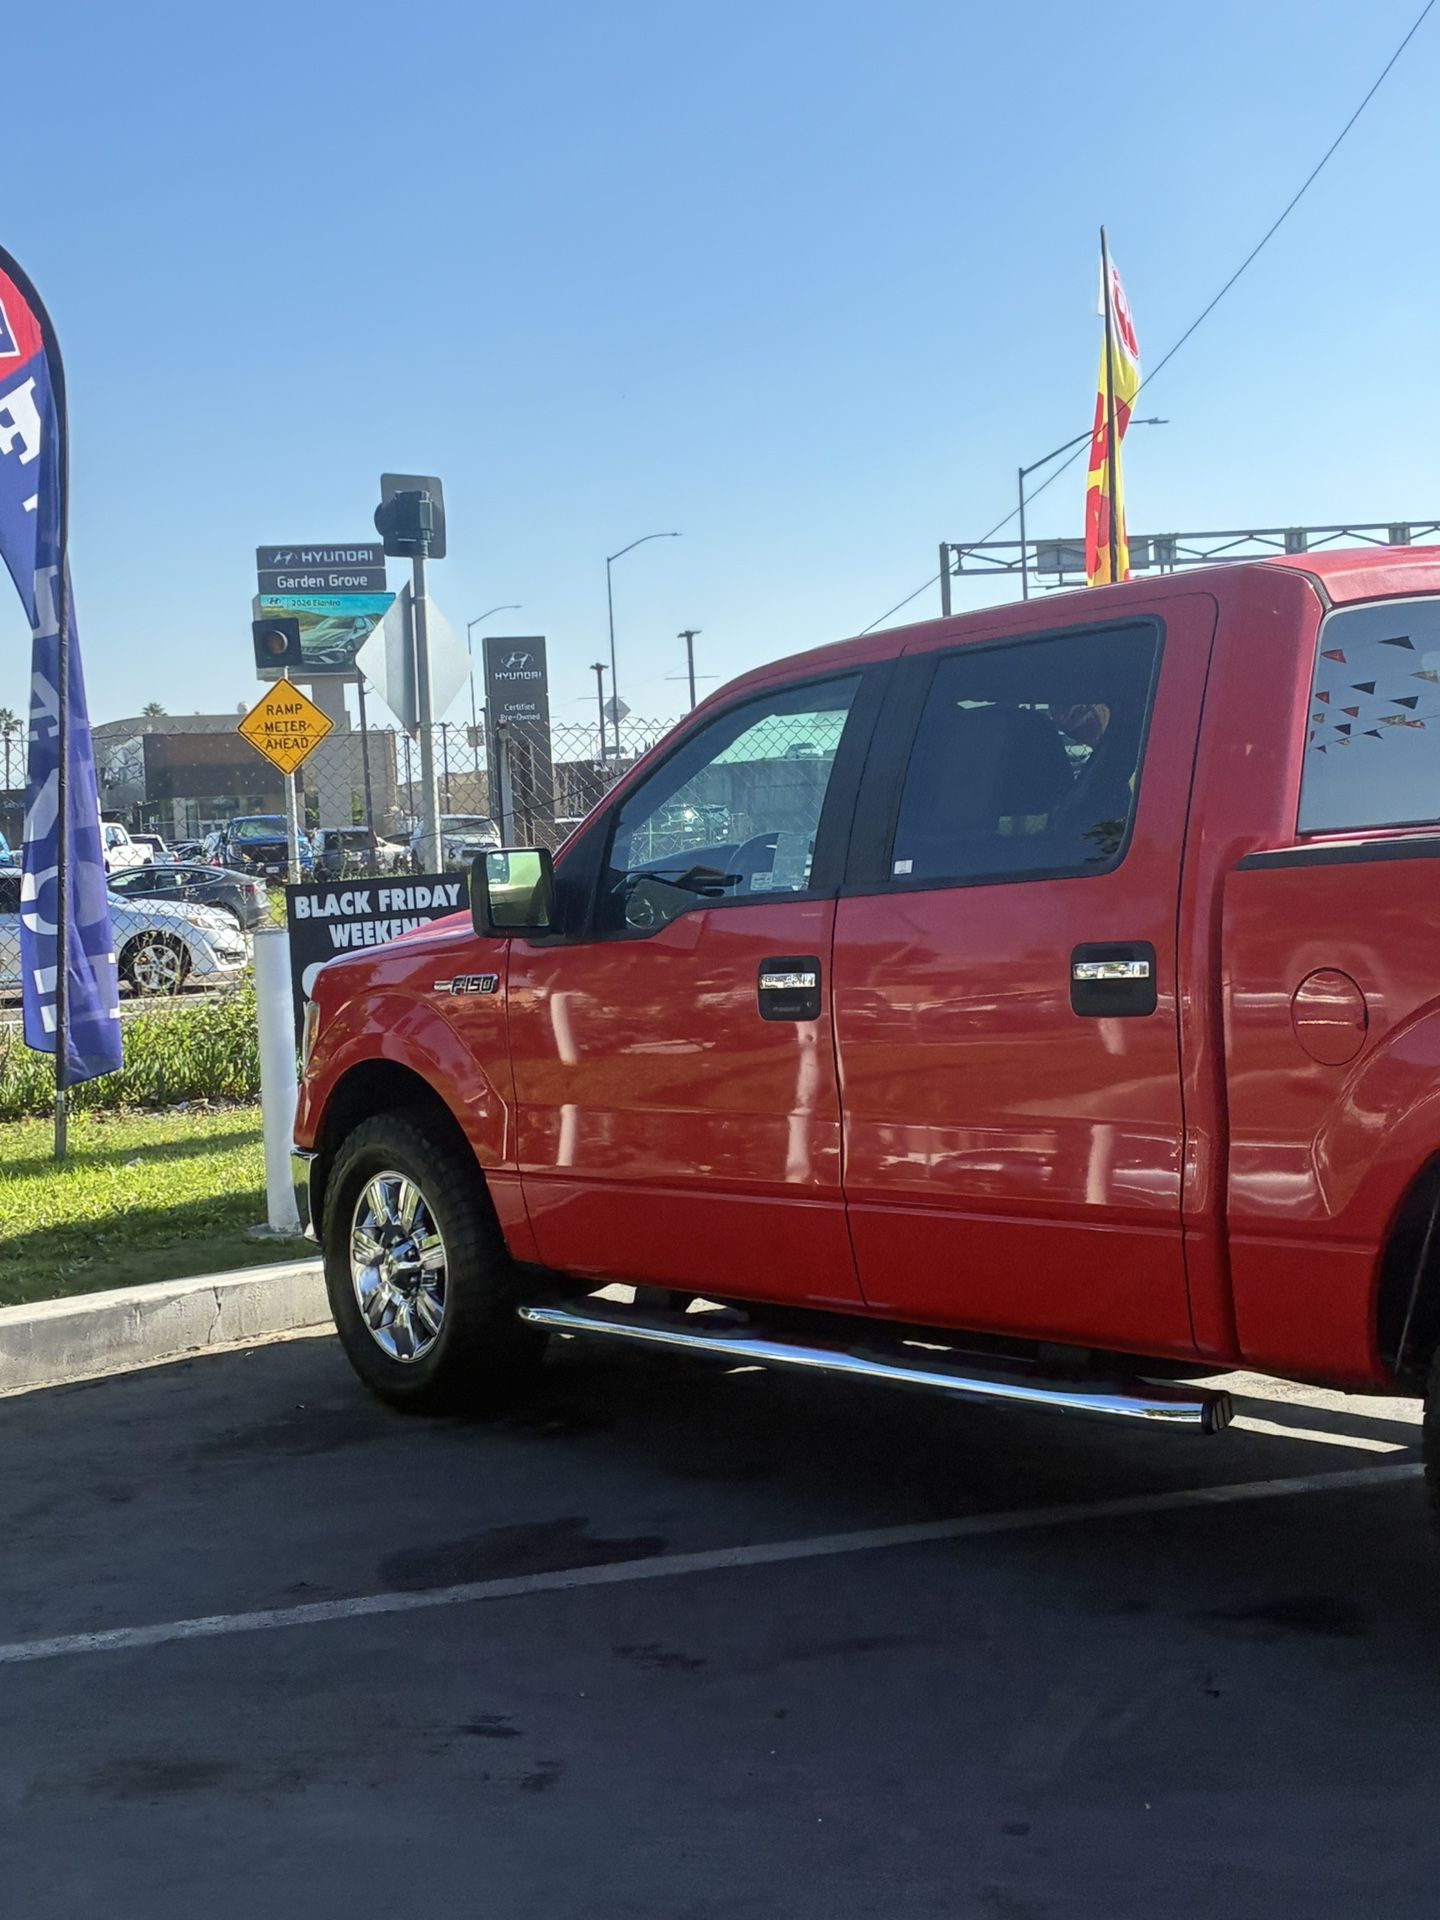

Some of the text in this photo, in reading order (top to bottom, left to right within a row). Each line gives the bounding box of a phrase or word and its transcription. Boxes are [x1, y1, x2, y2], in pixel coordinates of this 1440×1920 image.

[301, 550, 373, 563] HYUNDAI
[277, 574, 368, 588] Garden Grove
[292, 599, 311, 607] 2026
[313, 599, 341, 607] Elantra
[494, 671, 542, 680] HYUNDAI
[266, 703, 303, 716] RAMP
[504, 703, 535, 711] Certified
[500, 713, 541, 721] Pre-Owned
[264, 720, 307, 733] METER
[265, 737, 309, 750] AHEAD
[294, 883, 461, 919] BLACK FRIDAY
